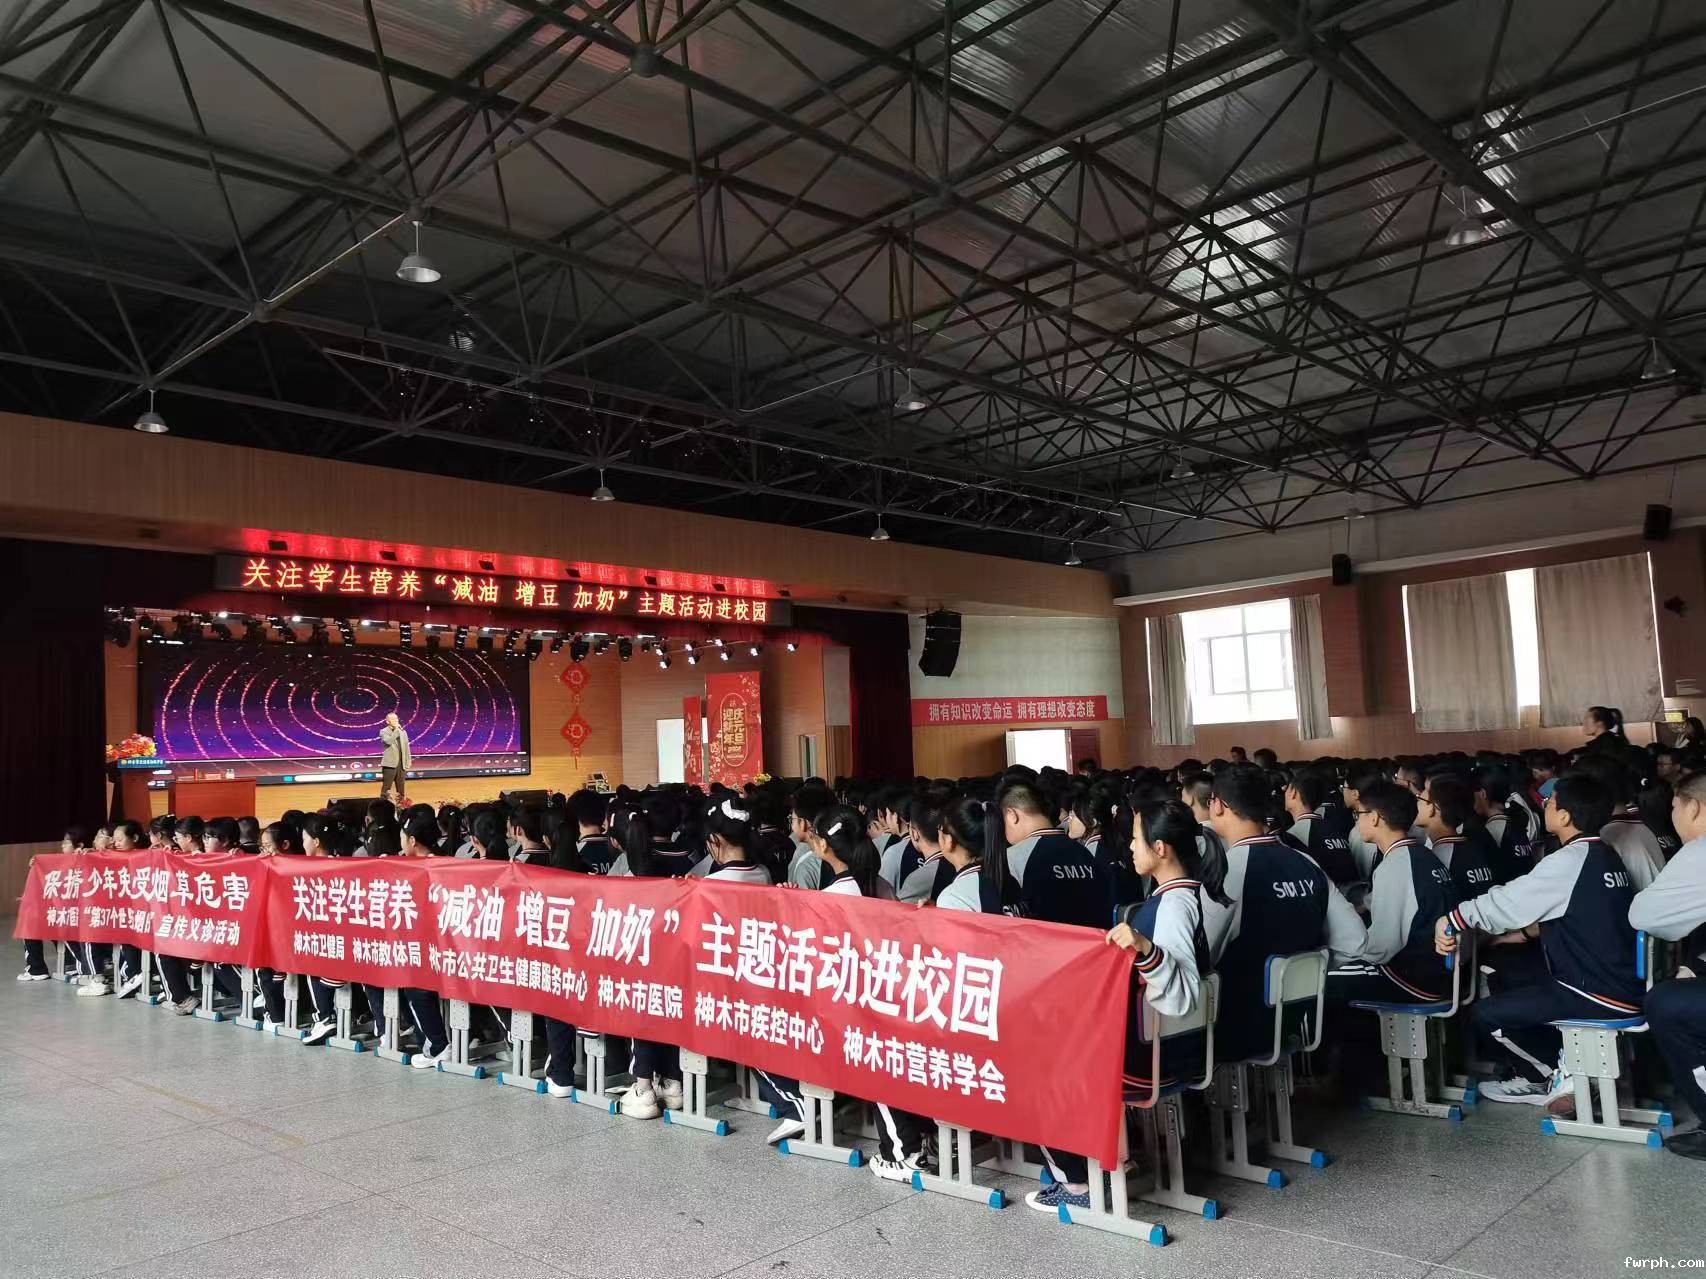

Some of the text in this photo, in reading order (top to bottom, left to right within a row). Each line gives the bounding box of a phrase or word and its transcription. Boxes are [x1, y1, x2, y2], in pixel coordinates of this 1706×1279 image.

[241, 559, 422, 599] 关注学生营养
[515, 584, 560, 608] 增豆
[639, 595, 767, 623] 主题活动进校园
[929, 699, 1096, 721] 拥有知识改变命运 拥有理想改变态度
[1052, 864, 1095, 880] SMJY
[155, 913, 241, 946] 宣传义诊活动
[292, 876, 419, 930] 关注学生营养
[515, 891, 575, 951] 增豆
[696, 912, 1004, 1042] 主题活动进校园
[293, 929, 345, 961] 神木市卫健局
[352, 937, 422, 968] 神木市教体局
[597, 975, 683, 1020] 神木市医院
[694, 991, 825, 1056] 神木市疾控中心
[843, 1025, 1007, 1104] 神木市营养学会
